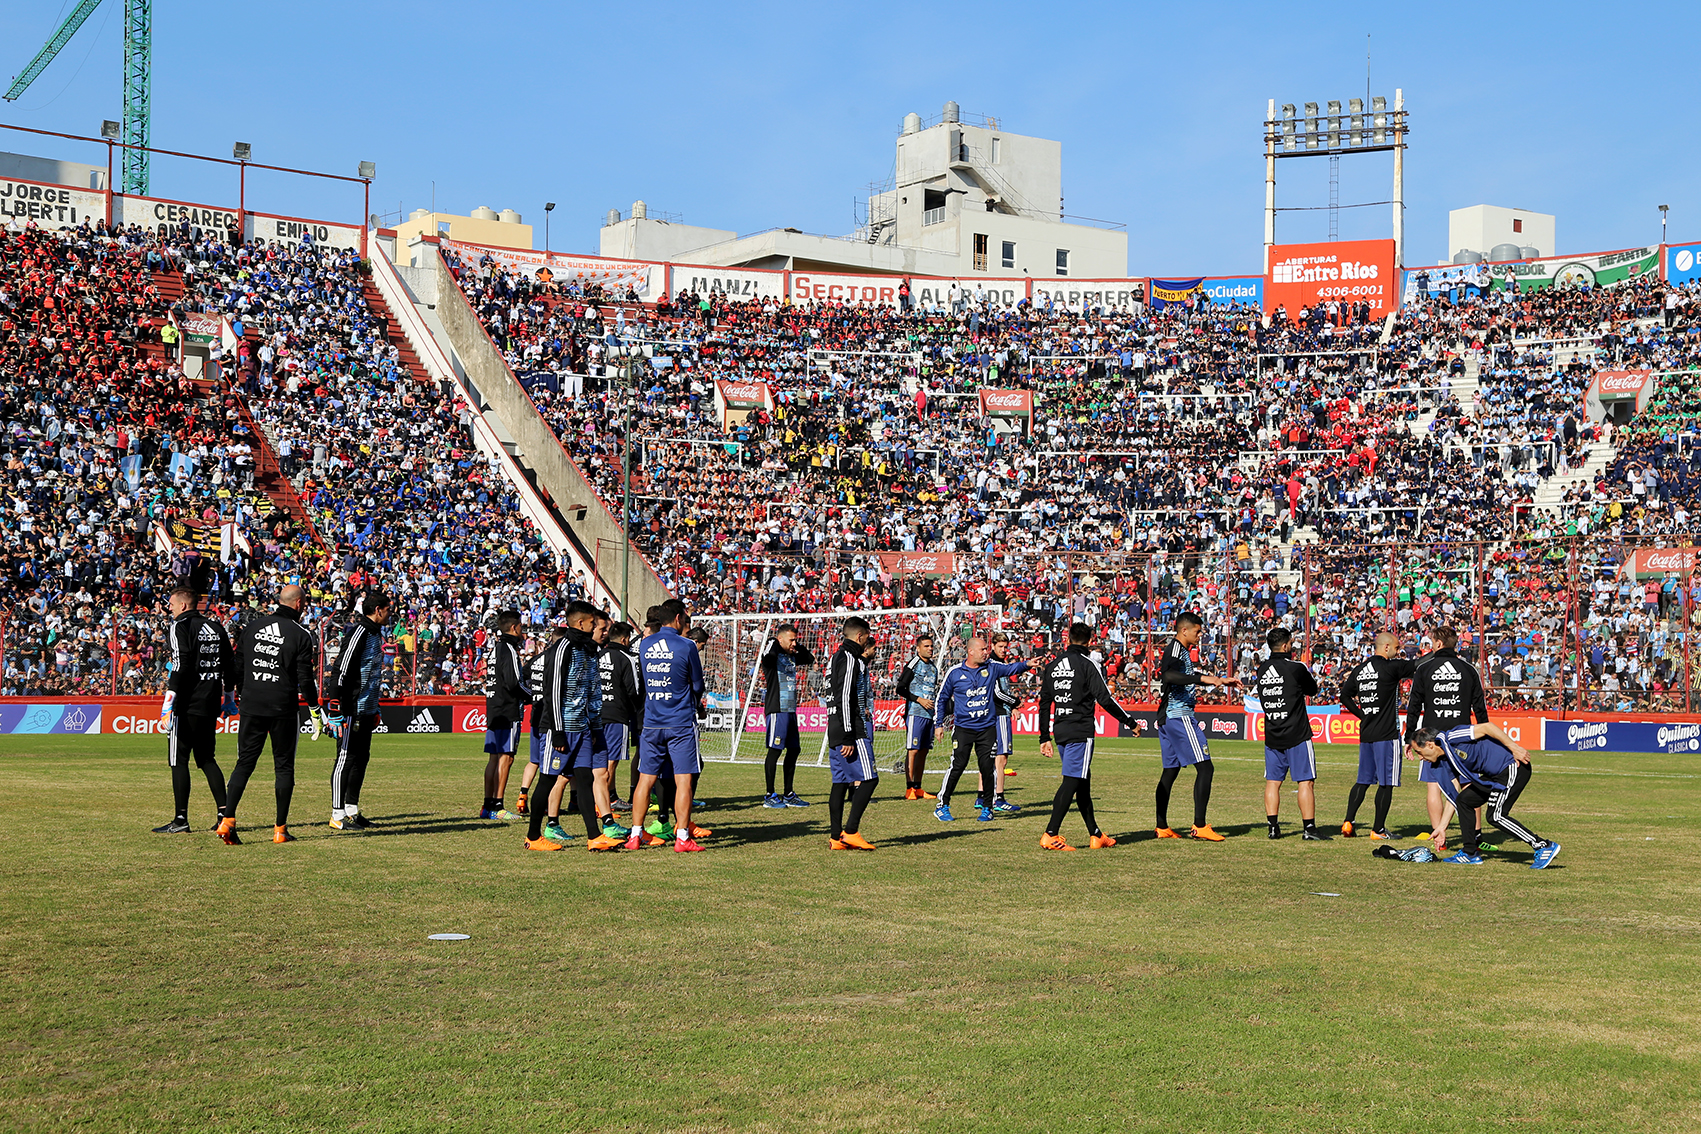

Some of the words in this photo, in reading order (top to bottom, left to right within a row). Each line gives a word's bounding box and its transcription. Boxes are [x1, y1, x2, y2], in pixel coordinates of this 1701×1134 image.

[0, 183, 70, 204] JORGE
[276, 220, 328, 242] EMIIO
[1284, 255, 1337, 266] ABERTURAS
[1292, 265, 1339, 283] Entre
[1340, 261, 1379, 280] Ríos
[1316, 285, 1384, 297] 4306-6001
[1602, 374, 1645, 390] Coca-Cola
[723, 384, 761, 399] Coca-Cola
[986, 393, 1025, 407] Coca-Cola
[254, 632, 285, 645] adidas
[644, 650, 674, 660] adidas
[252, 658, 277, 670] Claro
[199, 672, 220, 681] YPF
[252, 671, 280, 682] YPF
[1259, 675, 1284, 685] adidas
[1431, 672, 1462, 681] adidas
[647, 677, 669, 687] Claro
[648, 692, 673, 701] YPF
[1433, 697, 1458, 706] Claro
[967, 699, 987, 708] Claro
[1264, 699, 1283, 709] Claro
[969, 709, 990, 718] YPF
[1266, 712, 1288, 720] YPF
[1362, 707, 1380, 715] YPF
[1434, 710, 1462, 718] YPF
[406, 723, 440, 733] adidas
[1211, 718, 1238, 735] Fargo
[1567, 721, 1608, 745] Quilmes
[1657, 724, 1700, 748] Quilmes
